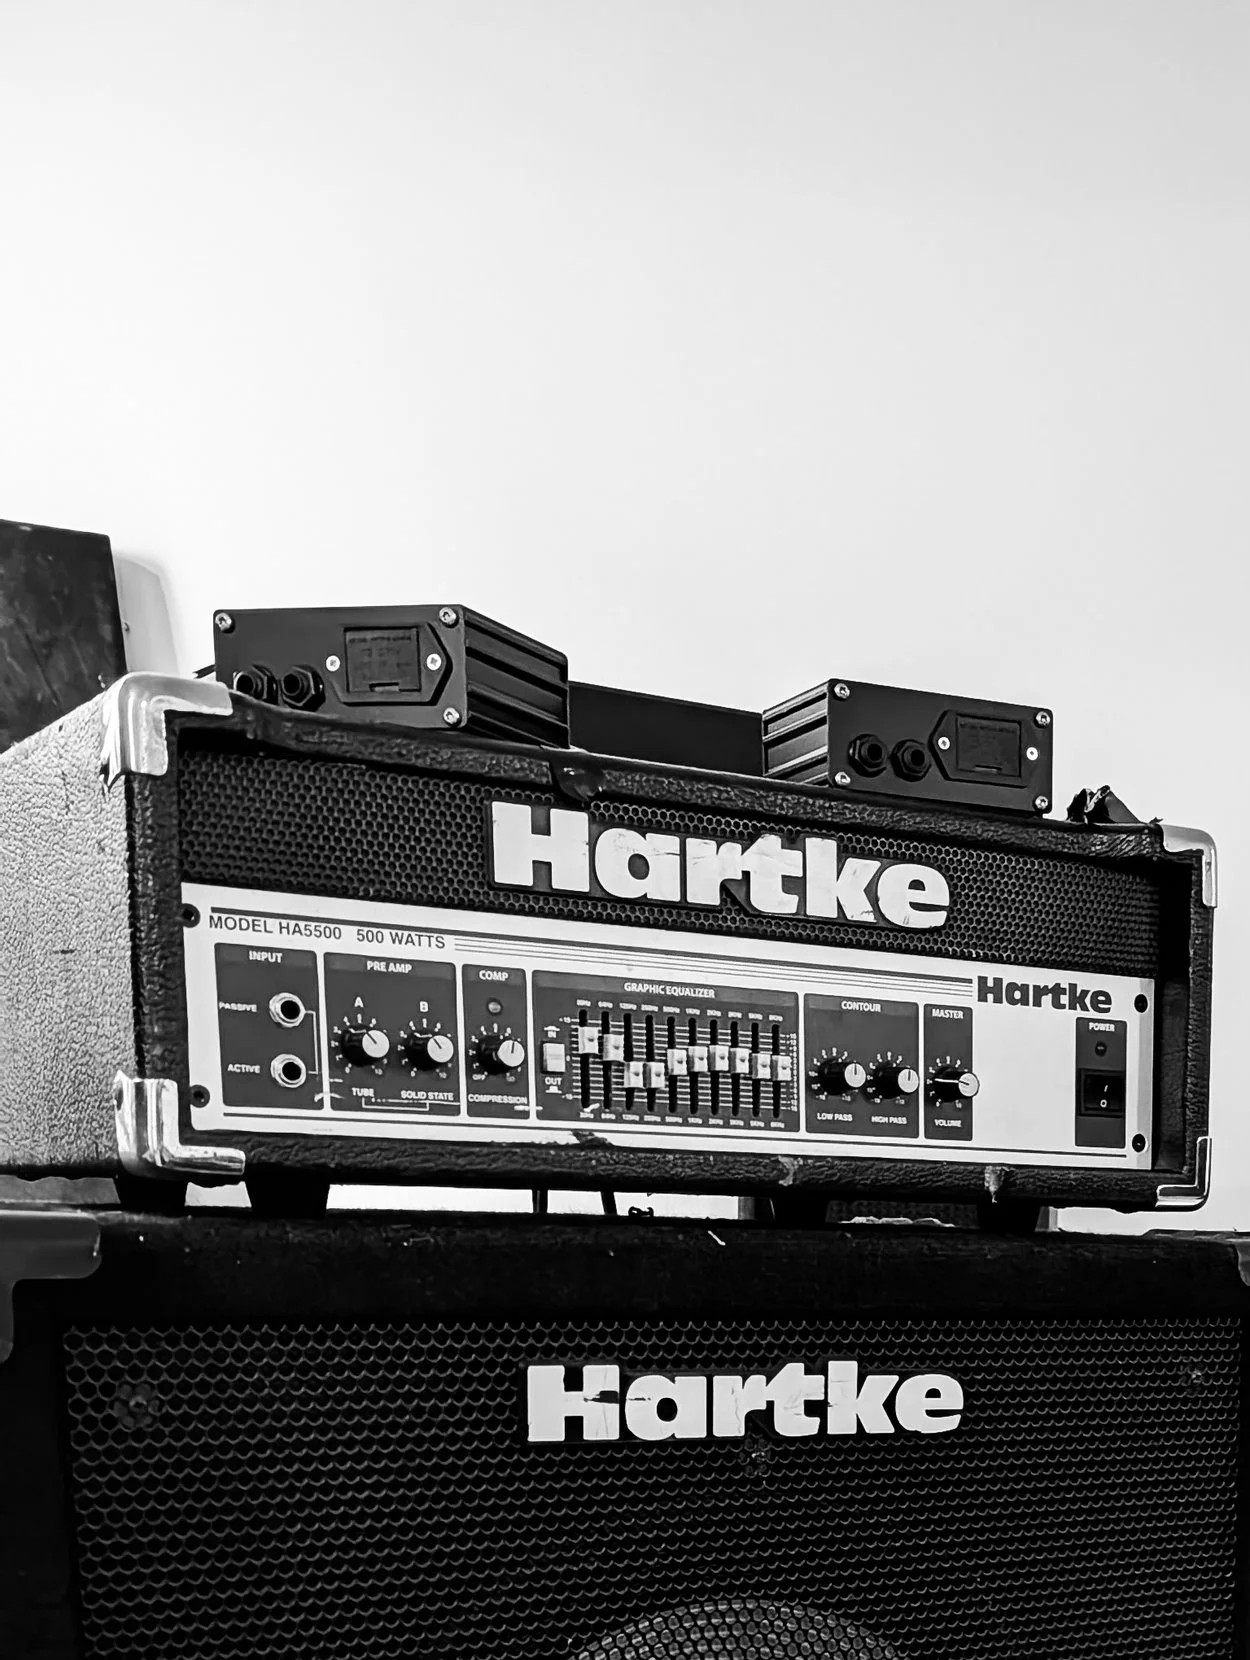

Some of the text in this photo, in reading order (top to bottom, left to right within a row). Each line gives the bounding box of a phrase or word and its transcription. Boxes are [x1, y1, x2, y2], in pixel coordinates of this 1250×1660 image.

[492, 801, 950, 929] Hartke
[209, 915, 446, 950] MODEL HA5500 500 WATTS
[249, 951, 283, 963] INPUT
[366, 960, 412, 974] PRE AMP
[479, 970, 509, 981] COMP
[624, 982, 715, 998] GRAPHIC EQUALIZER
[977, 976, 1113, 1014] Hartke
[354, 996, 364, 1008] A
[419, 1001, 429, 1012] B
[841, 1000, 881, 1013] CONTOUR
[932, 1009, 964, 1019] MASTER
[1088, 1022, 1115, 1032] POWER
[228, 1064, 261, 1074] ACTIVE
[545, 1077, 562, 1085] OUT
[352, 1087, 375, 1097] TUBE
[400, 1090, 454, 1101] SOLID STATE
[527, 1360, 964, 1441] Hartke
